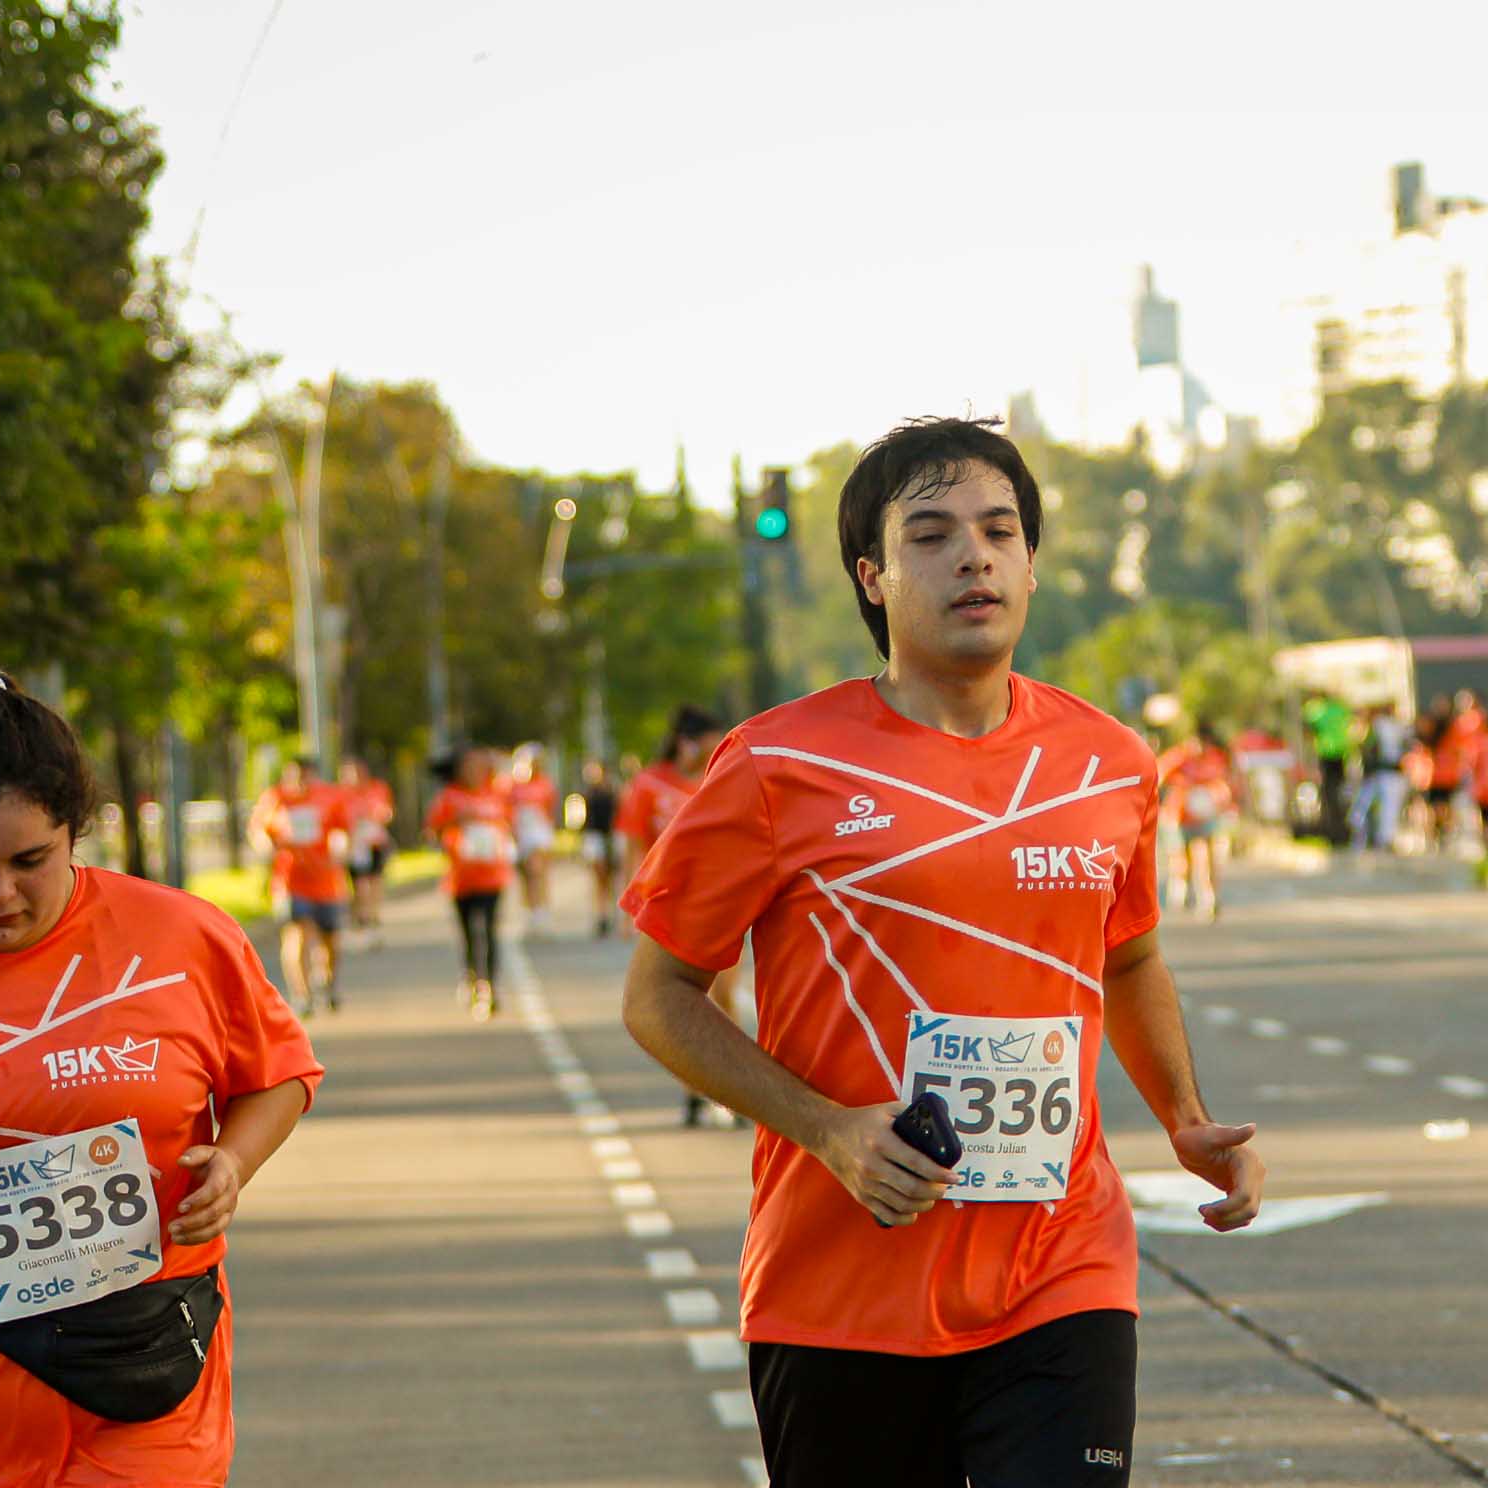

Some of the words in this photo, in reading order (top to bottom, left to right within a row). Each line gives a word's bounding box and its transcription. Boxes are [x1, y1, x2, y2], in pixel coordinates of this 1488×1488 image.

[1011, 846, 1074, 878] 15K
[1016, 881, 1075, 890] PUERTO
[930, 1033, 983, 1062] 15K
[1047, 1041, 1060, 1054] 4K
[42, 1046, 106, 1080] 15K
[50, 1076, 107, 1090] PUERTO
[113, 1073, 158, 1082] NORTE
[95, 1142, 114, 1157] 4K
[955, 1166, 986, 1188] de
[18, 1250, 76, 1271] Giacomelli
[79, 1237, 125, 1257] Milagros
[17, 1276, 75, 1304] osde
[1085, 1448, 1123, 1468] USH
